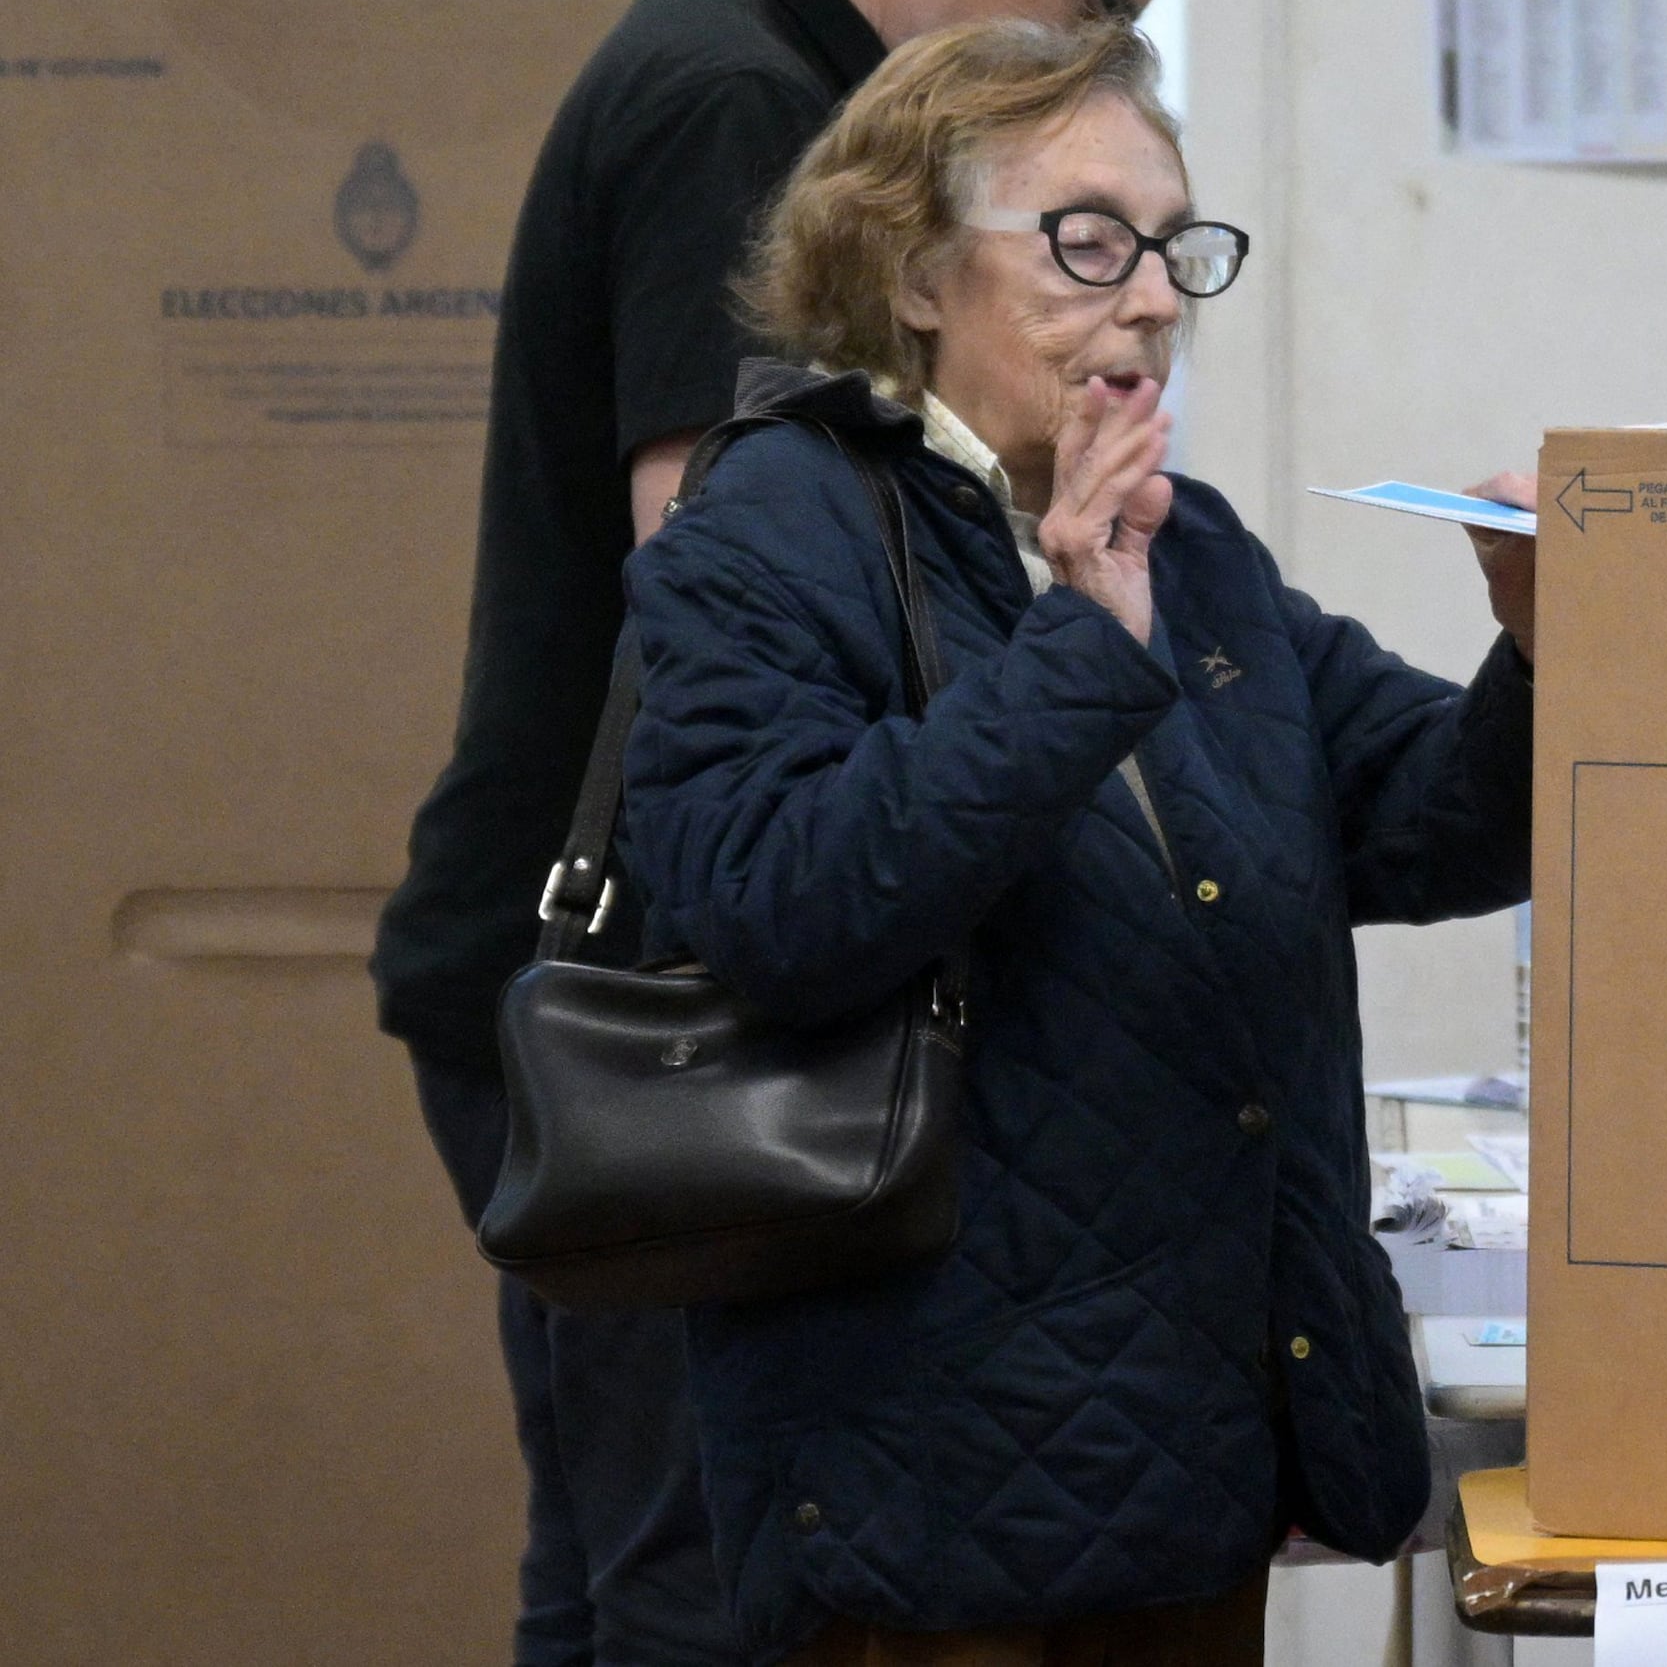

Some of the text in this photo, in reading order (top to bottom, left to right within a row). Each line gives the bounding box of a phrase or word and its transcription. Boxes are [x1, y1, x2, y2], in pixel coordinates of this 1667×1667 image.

[161, 287, 503, 319] ELECCIONES ARGEN
[1640, 497, 1657, 508] AL
[1650, 511, 1667, 523] DE
